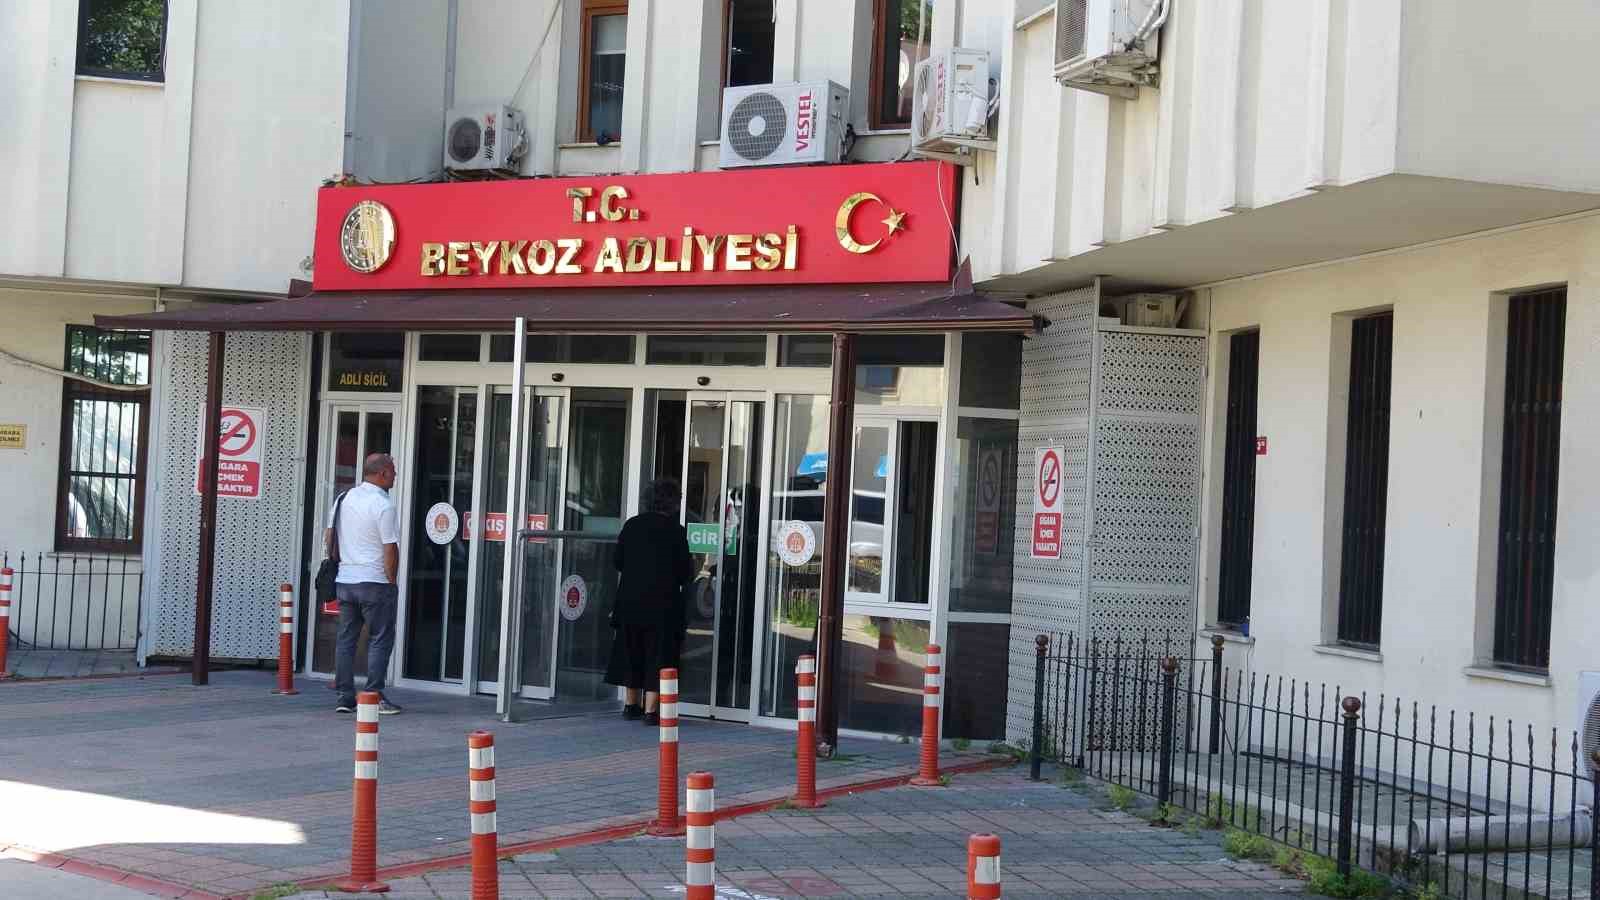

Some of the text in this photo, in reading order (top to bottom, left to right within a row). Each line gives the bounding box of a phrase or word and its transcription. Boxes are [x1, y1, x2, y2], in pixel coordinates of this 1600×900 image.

[796, 88, 812, 152] VESTEL
[566, 185, 639, 222] T.C.
[420, 224, 799, 276] BEYKOZ ADLİYESİ
[217, 483, 253, 493] SAKTIR
